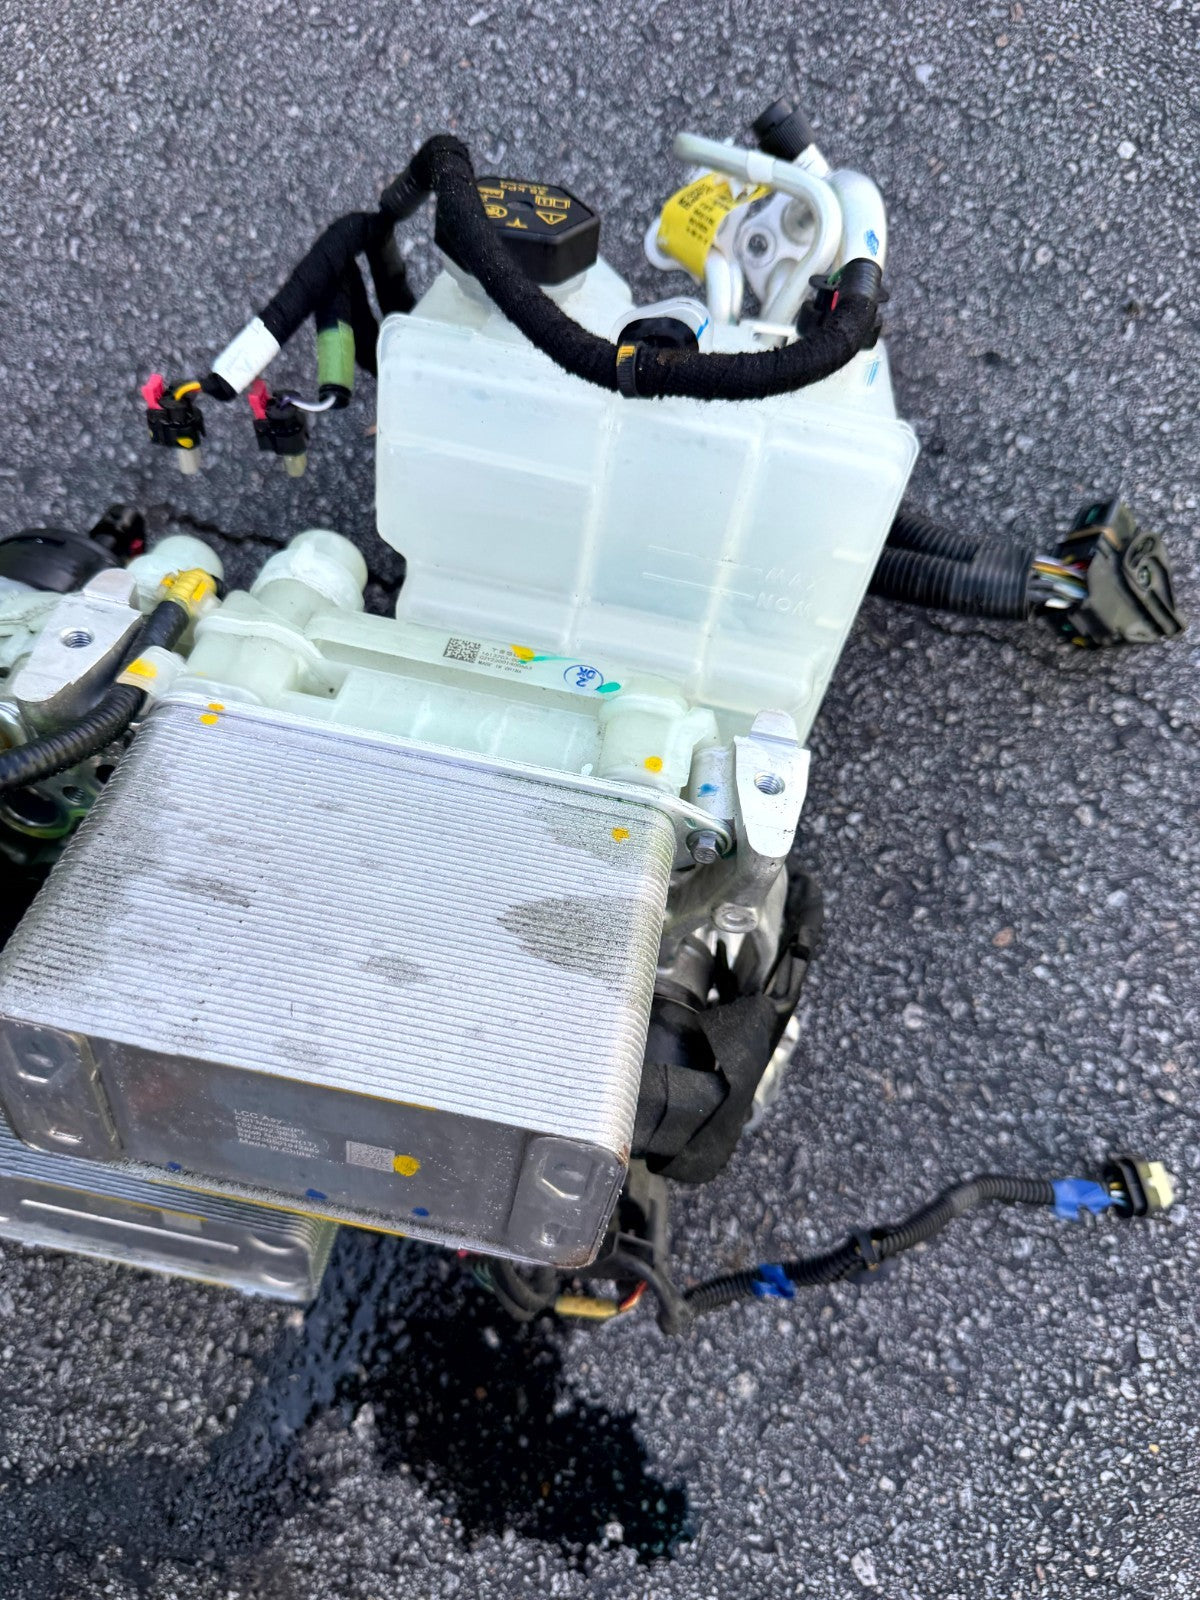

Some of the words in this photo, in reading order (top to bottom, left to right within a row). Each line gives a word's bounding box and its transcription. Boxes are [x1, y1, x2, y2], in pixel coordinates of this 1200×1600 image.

[756, 592, 813, 617] NOM
[576, 666, 596, 681] OK
[575, 676, 587, 688] 2
[234, 1109, 259, 1119] LCC
